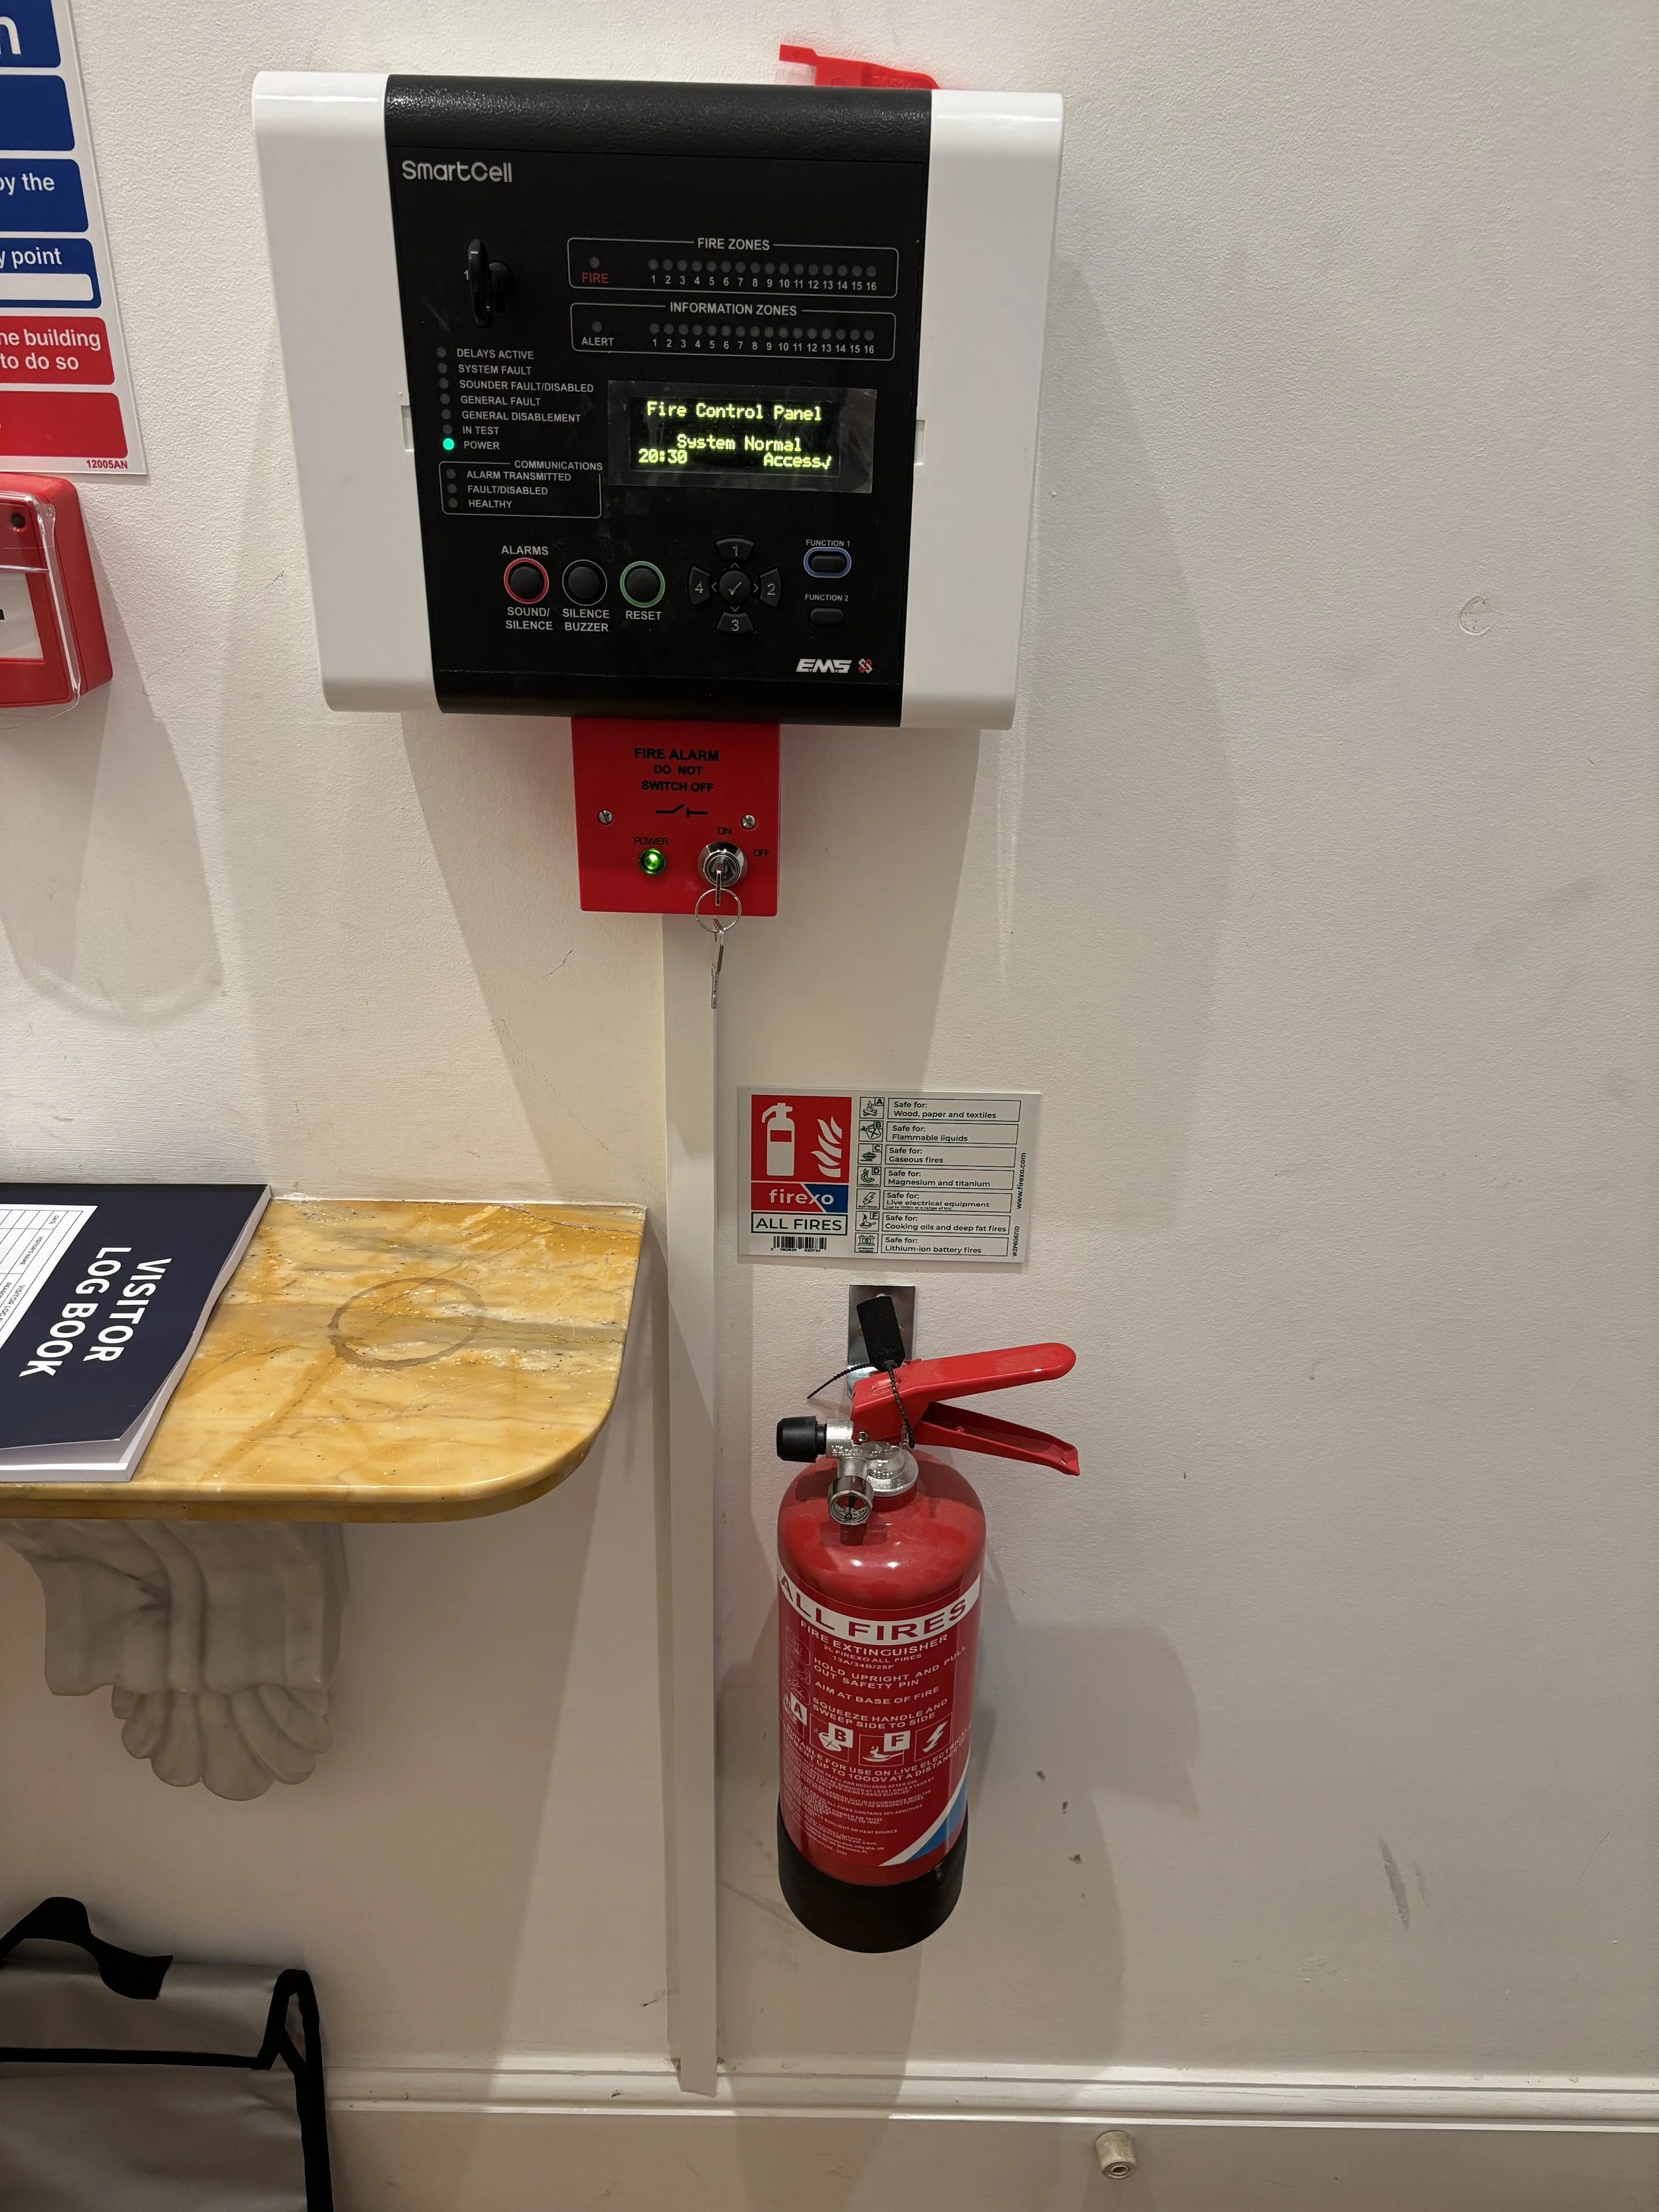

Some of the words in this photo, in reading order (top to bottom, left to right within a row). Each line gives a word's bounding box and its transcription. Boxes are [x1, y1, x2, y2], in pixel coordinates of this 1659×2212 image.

[401, 161, 512, 183] SmartCell
[21, 173, 55, 191] the
[698, 238, 725, 249] FIRE
[729, 239, 770, 250] ZONES
[11, 247, 62, 269] point
[581, 273, 609, 283] FIRE
[652, 275, 656, 284] 1
[666, 275, 671, 284] 2
[680, 276, 685, 285] 3
[694, 276, 700, 285] 4
[709, 277, 714, 285] 5
[723, 277, 729, 286] 6
[738, 278, 743, 287] 7
[753, 278, 758, 287] 8
[767, 278, 772, 287] 9
[779, 279, 790, 288] 10
[794, 279, 804, 289] 11
[808, 279, 819, 289] 12
[823, 280, 833, 289] 13
[837, 281, 847, 289] 14
[852, 281, 862, 290] 15
[866, 281, 877, 291] 16
[670, 302, 753, 315] INFORMATION
[757, 305, 797, 317] ZONES
[23, 329, 101, 351] building
[581, 337, 614, 346] ALERT
[457, 348, 496, 358] DELAYS
[498, 350, 534, 360] ACTIVE
[25, 353, 49, 370] do
[56, 356, 79, 370] so
[459, 364, 498, 374] SYSTEM
[501, 366, 532, 375] FAULT
[459, 380, 508, 390] SOUNDER
[511, 382, 594, 392] FAULT/DISABLED
[461, 396, 508, 405] GENERAL
[510, 397, 541, 406] FAULT
[462, 411, 509, 420] GENERAL
[512, 412, 581, 422] DISABLEMENT
[647, 401, 686, 417] Fire
[696, 403, 763, 419] Control
[774, 406, 822, 421] Panel
[474, 426, 499, 435] TEST
[464, 441, 500, 450] POWER
[677, 434, 735, 449] System
[745, 437, 801, 452] Normal
[638, 449, 687, 465] 20:30
[86, 460, 127, 469] 12005AN
[514, 460, 603, 471] COMMUNICATIONS
[467, 471, 500, 479] ALARM
[503, 471, 571, 481] TRANSMITTED
[468, 485, 548, 495] FAULT/DISABLED
[469, 500, 512, 508] HEALTHY
[501, 545, 548, 555] ALARMS
[733, 544, 738, 556] 1
[695, 581, 703, 593] 4
[767, 583, 776, 595] 2
[507, 607, 549, 617] SOUND/
[562, 608, 610, 619] SILENCE
[625, 611, 662, 621] RESET
[506, 619, 553, 630] SILENCE
[565, 621, 609, 632] BUZZER
[731, 619, 739, 632] 3
[634, 748, 664, 759] FIRE
[669, 749, 719, 761] ALARM
[654, 765, 671, 774] DO
[678, 766, 702, 776] NOT
[641, 780, 687, 792] SWITCH
[690, 782, 714, 792] OFF
[1017, 1153, 1027, 1209] www.firexo.com
[769, 1189, 834, 1204] firexo
[756, 1218, 788, 1230] ALL
[794, 1218, 841, 1231] FIRES
[75, 1247, 132, 1294] LOG
[83, 1258, 172, 1361] VISITOR
[19, 1303, 98, 1377] BOOK
[780, 1576, 835, 1631] ALL
[848, 1599, 966, 1641] FIRES
[801, 1620, 828, 1644] FIRE
[833, 1634, 948, 1656] EXTINGUISHER
[814, 1658, 845, 1676] HOLD
[852, 1672, 910, 1682] UPRIGHT
[915, 1664, 939, 1678] AND
[944, 1645, 966, 1666] PULL
[814, 1664, 837, 1679] OUT
[843, 1678, 892, 1689] SAFETY
[899, 1679, 919, 1688] PIN
[815, 1681, 835, 1695] AIM
[837, 1692, 852, 1700] AT
[914, 1686, 940, 1700] FIRE
[813, 1697, 868, 1721] SQUEEZE
[872, 1710, 923, 1722] HANDLE
[926, 1698, 948, 1716] AND
[834, 1728, 846, 1742] B
[891, 1733, 904, 1747] F
